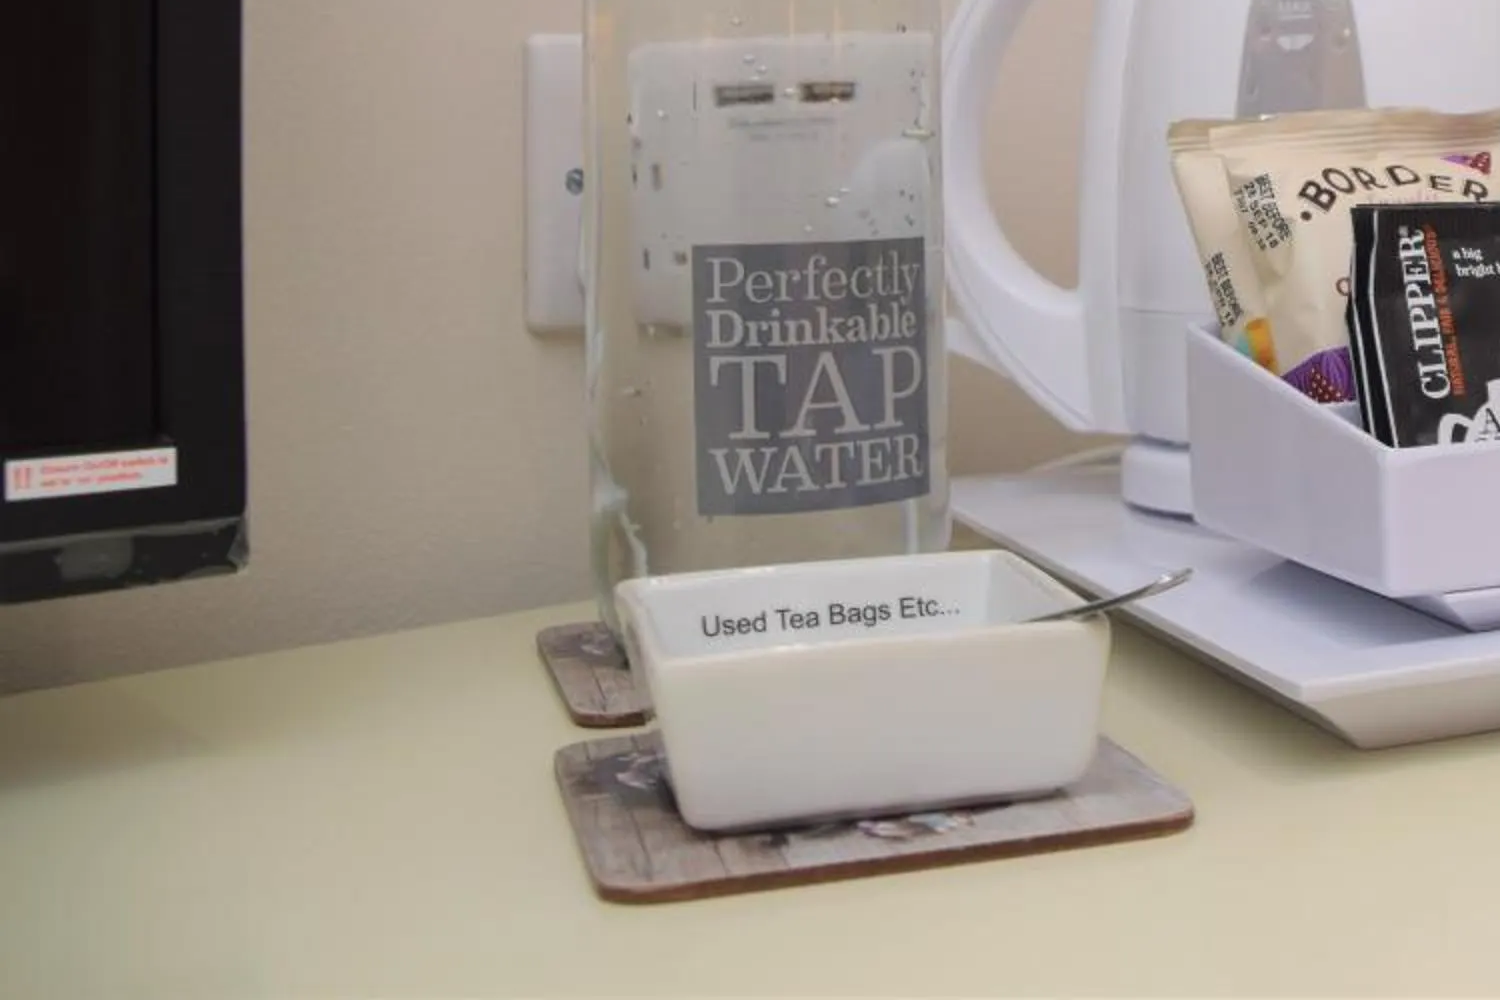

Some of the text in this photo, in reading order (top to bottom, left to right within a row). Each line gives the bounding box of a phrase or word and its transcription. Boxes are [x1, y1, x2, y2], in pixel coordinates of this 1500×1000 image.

[1299, 164, 1488, 213] BORDER
[705, 250, 921, 306] Perfectly
[1455, 262, 1495, 278] bright
[1461, 247, 1483, 262] big
[705, 301, 916, 348] Drinkable
[1398, 228, 1451, 399] CLIPPER
[709, 345, 922, 440] TAP
[708, 433, 924, 495] WATER
[701, 610, 767, 637] Used
[774, 608, 821, 631] Tea
[828, 602, 892, 627] Bags
